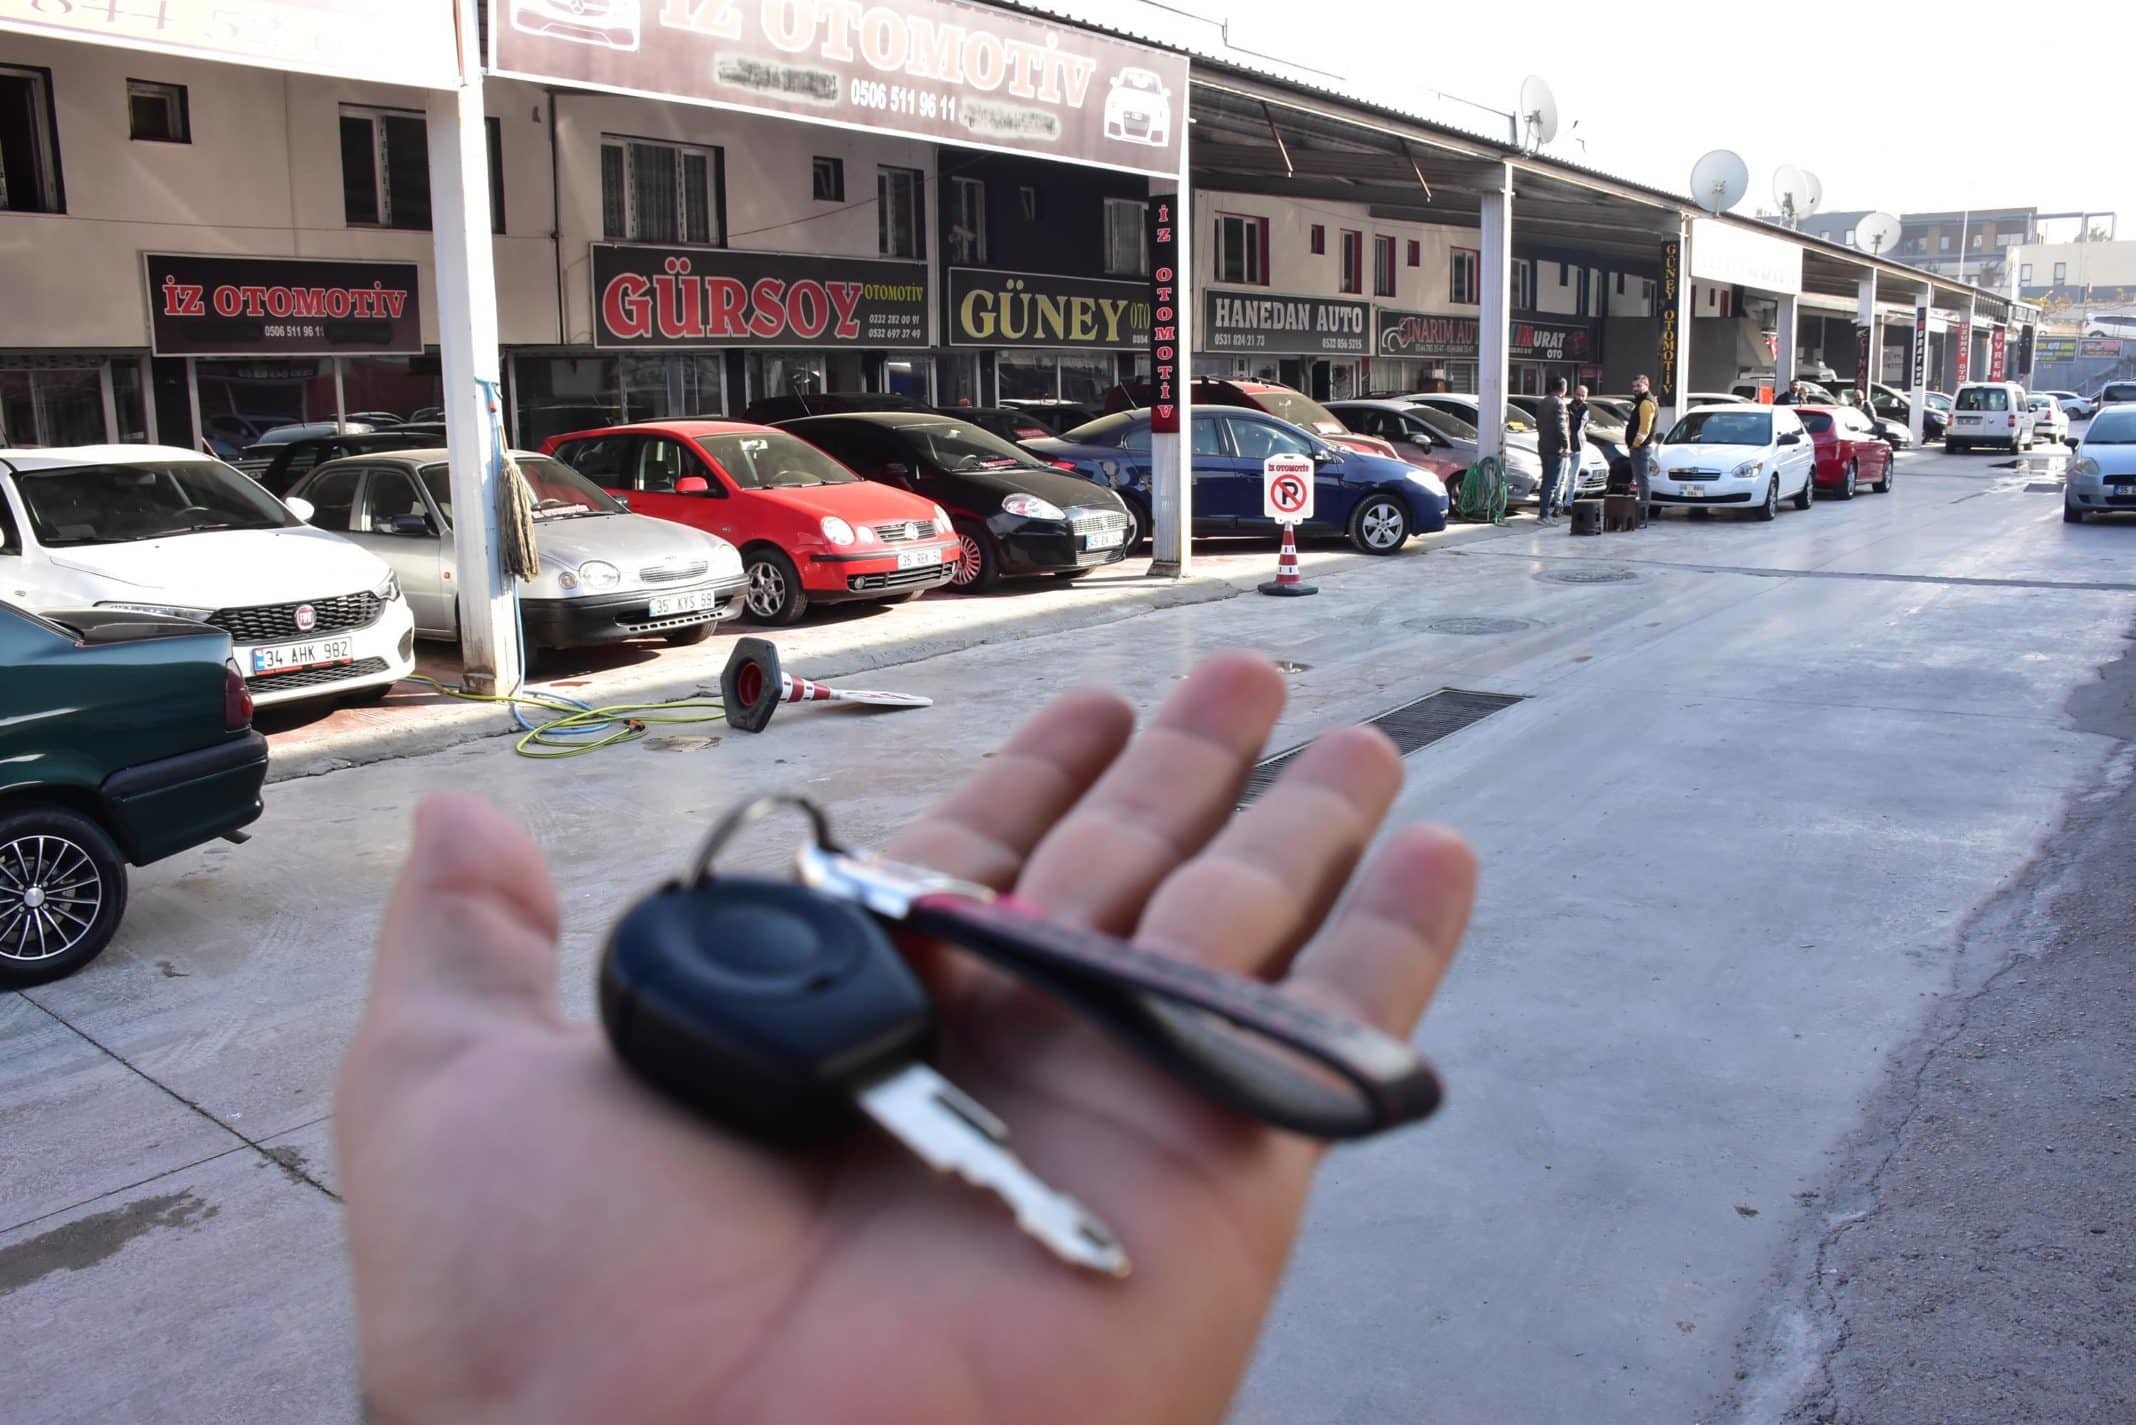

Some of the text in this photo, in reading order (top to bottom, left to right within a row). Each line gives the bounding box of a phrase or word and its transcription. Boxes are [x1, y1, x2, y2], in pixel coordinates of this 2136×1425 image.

[761, 0, 1097, 109] OTOMOTİV
[851, 78, 888, 110] 0506
[890, 87, 917, 115] 511
[920, 92, 937, 119] 96
[939, 96, 956, 121] 11
[163, 274, 407, 319] İZ OTOMOTİV
[602, 256, 924, 339] GÜRSOY OTOMOTİV
[960, 278, 1129, 342] GÜNEY
[1215, 298, 1363, 334] HANEDAN AUTO
[264, 325, 285, 337] 0506
[287, 326, 301, 337] 511
[1155, 267, 1175, 418] OTOMOTİV
[1456, 319, 1479, 344] AUT
[1546, 348, 1563, 359] OTO
[265, 641, 348, 667] 34 AHK 982
